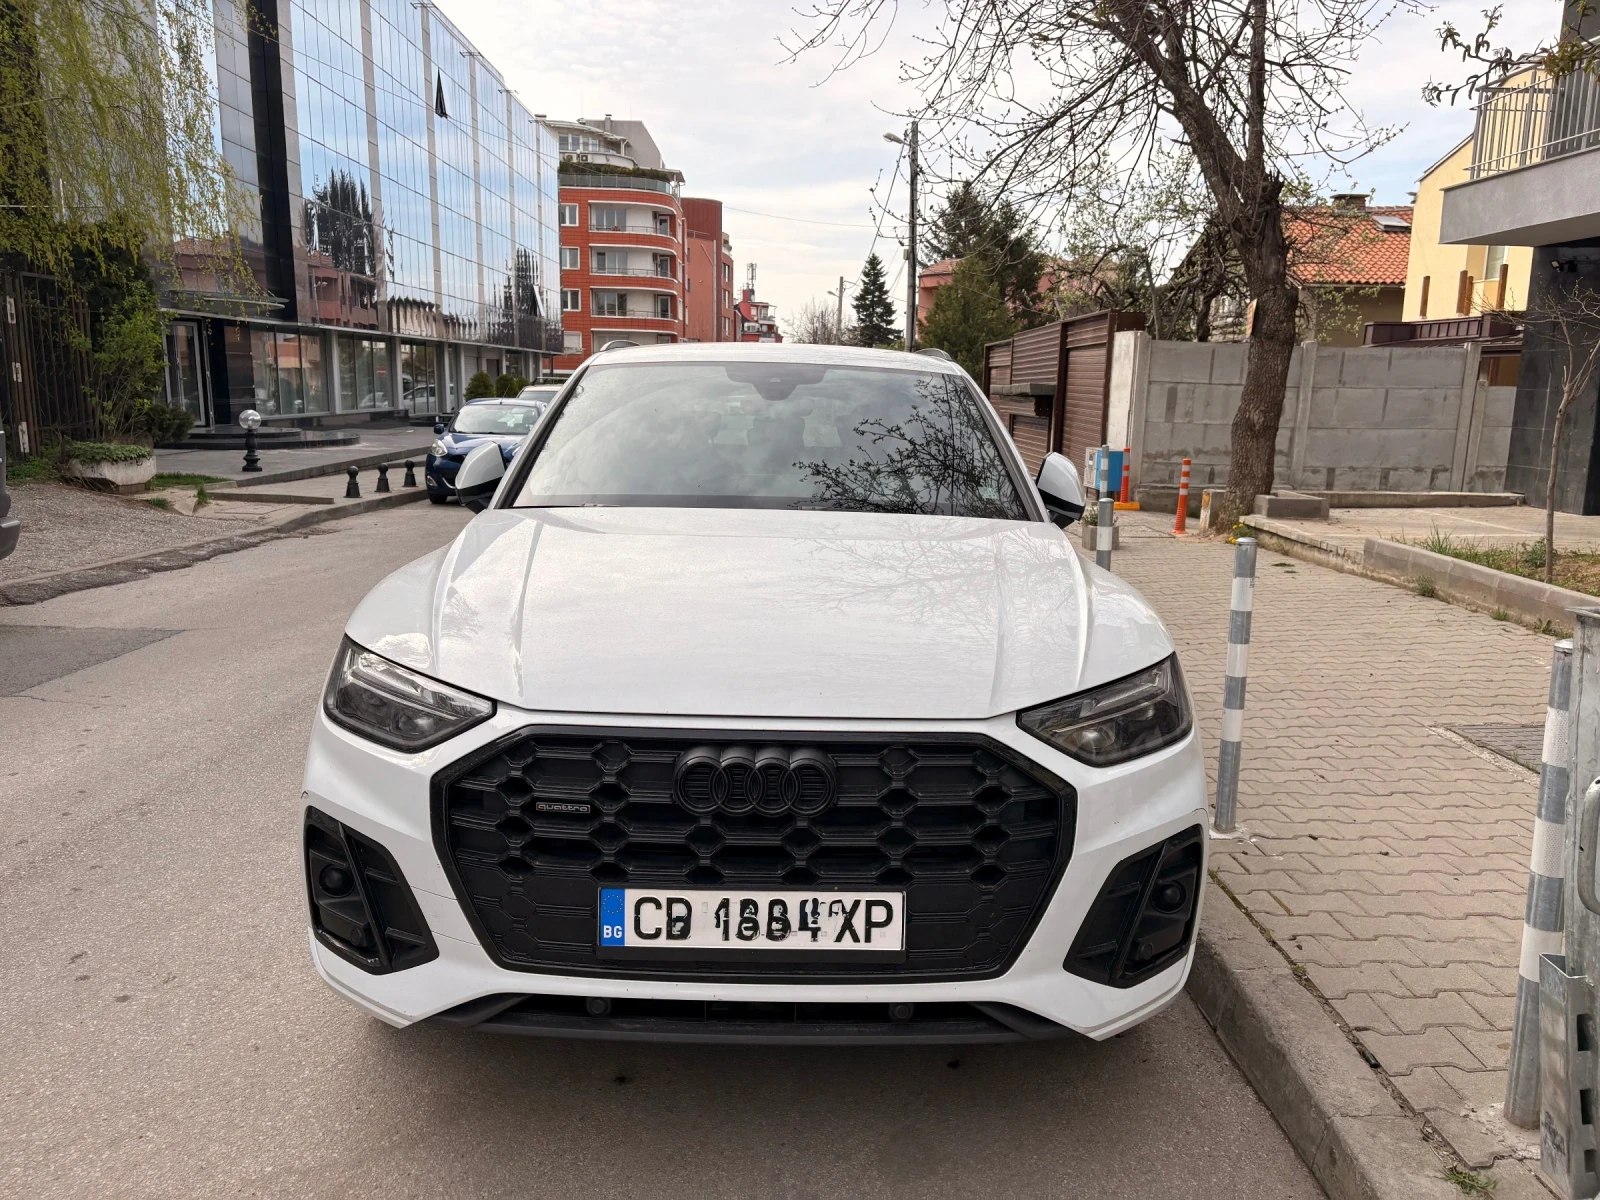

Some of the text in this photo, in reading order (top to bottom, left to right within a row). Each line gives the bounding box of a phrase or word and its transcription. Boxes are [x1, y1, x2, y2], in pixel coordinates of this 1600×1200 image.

[538, 804, 588, 812] quattro
[834, 899, 894, 943] XP
[604, 925, 623, 938] BG
